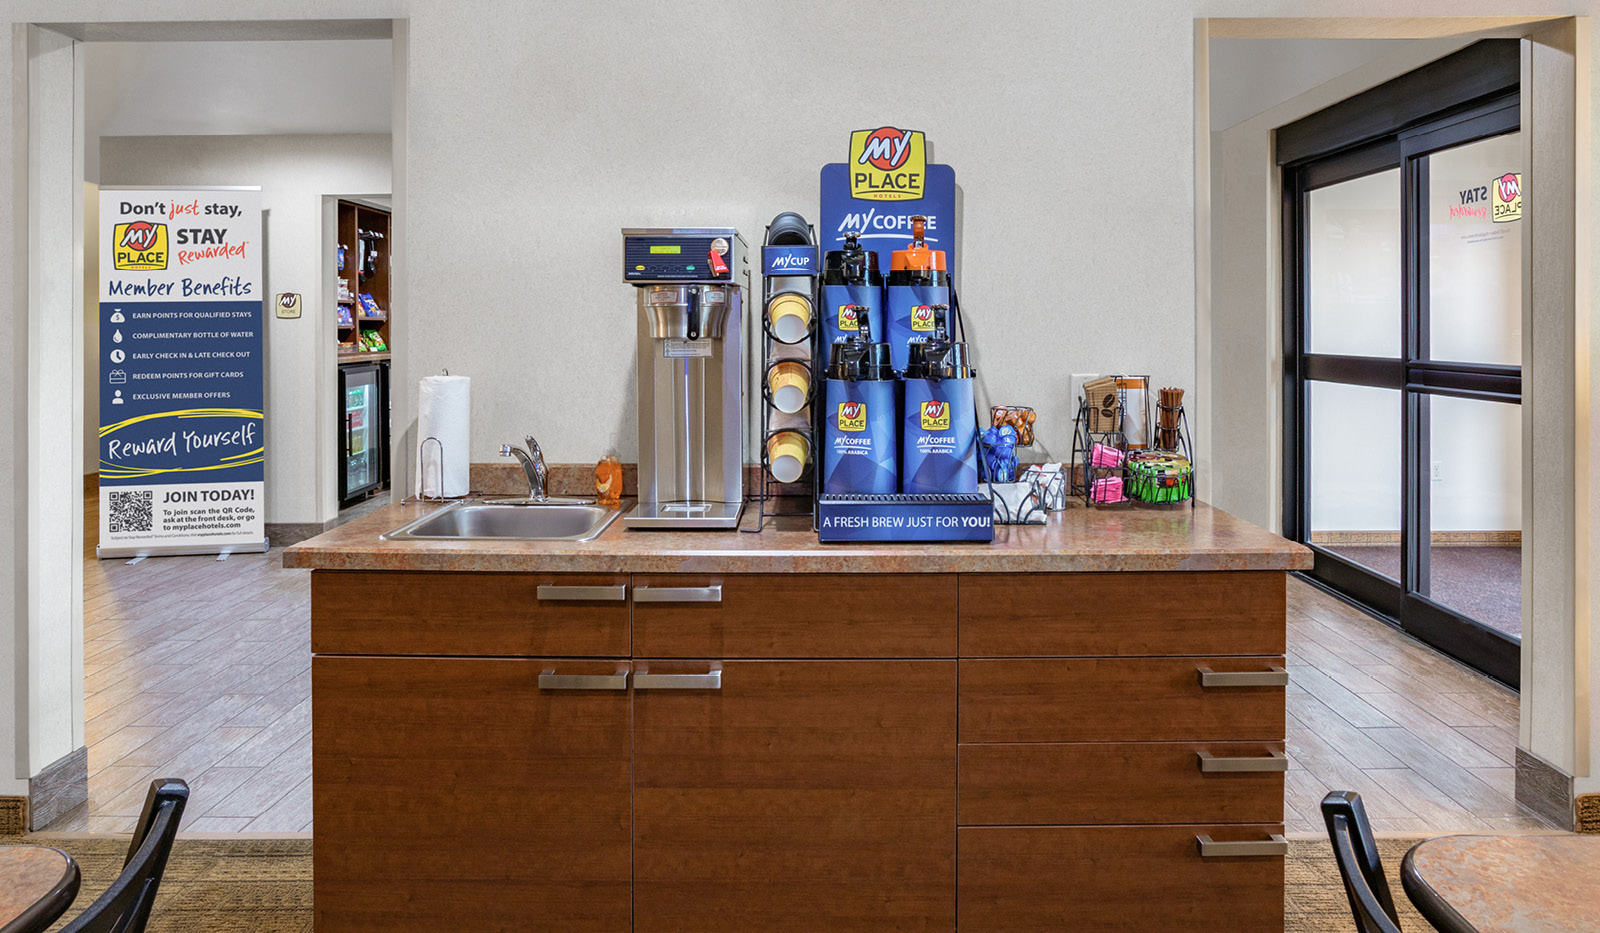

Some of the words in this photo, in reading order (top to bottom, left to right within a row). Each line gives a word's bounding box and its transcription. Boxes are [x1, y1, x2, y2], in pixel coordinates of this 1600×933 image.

[855, 173, 920, 189] PLACE
[168, 200, 200, 220] just
[204, 203, 242, 218] stay,
[177, 229, 227, 244] STAY
[118, 252, 164, 263] PLACE
[109, 278, 175, 296] Member
[181, 277, 252, 297] Benefits
[109, 432, 177, 459] Reward
[183, 422, 256, 453] Yourself
[163, 491, 197, 503] JOIN
[201, 489, 254, 502] TODAY!
[174, 509, 188, 517] join
[172, 522, 241, 531] myplacehotels.com
[823, 518, 831, 528] A
[834, 517, 869, 527] FRESH
[872, 517, 904, 527] BREW
[906, 517, 933, 528] JUST
[936, 517, 958, 527] FOR
[961, 517, 991, 527] YOU!
